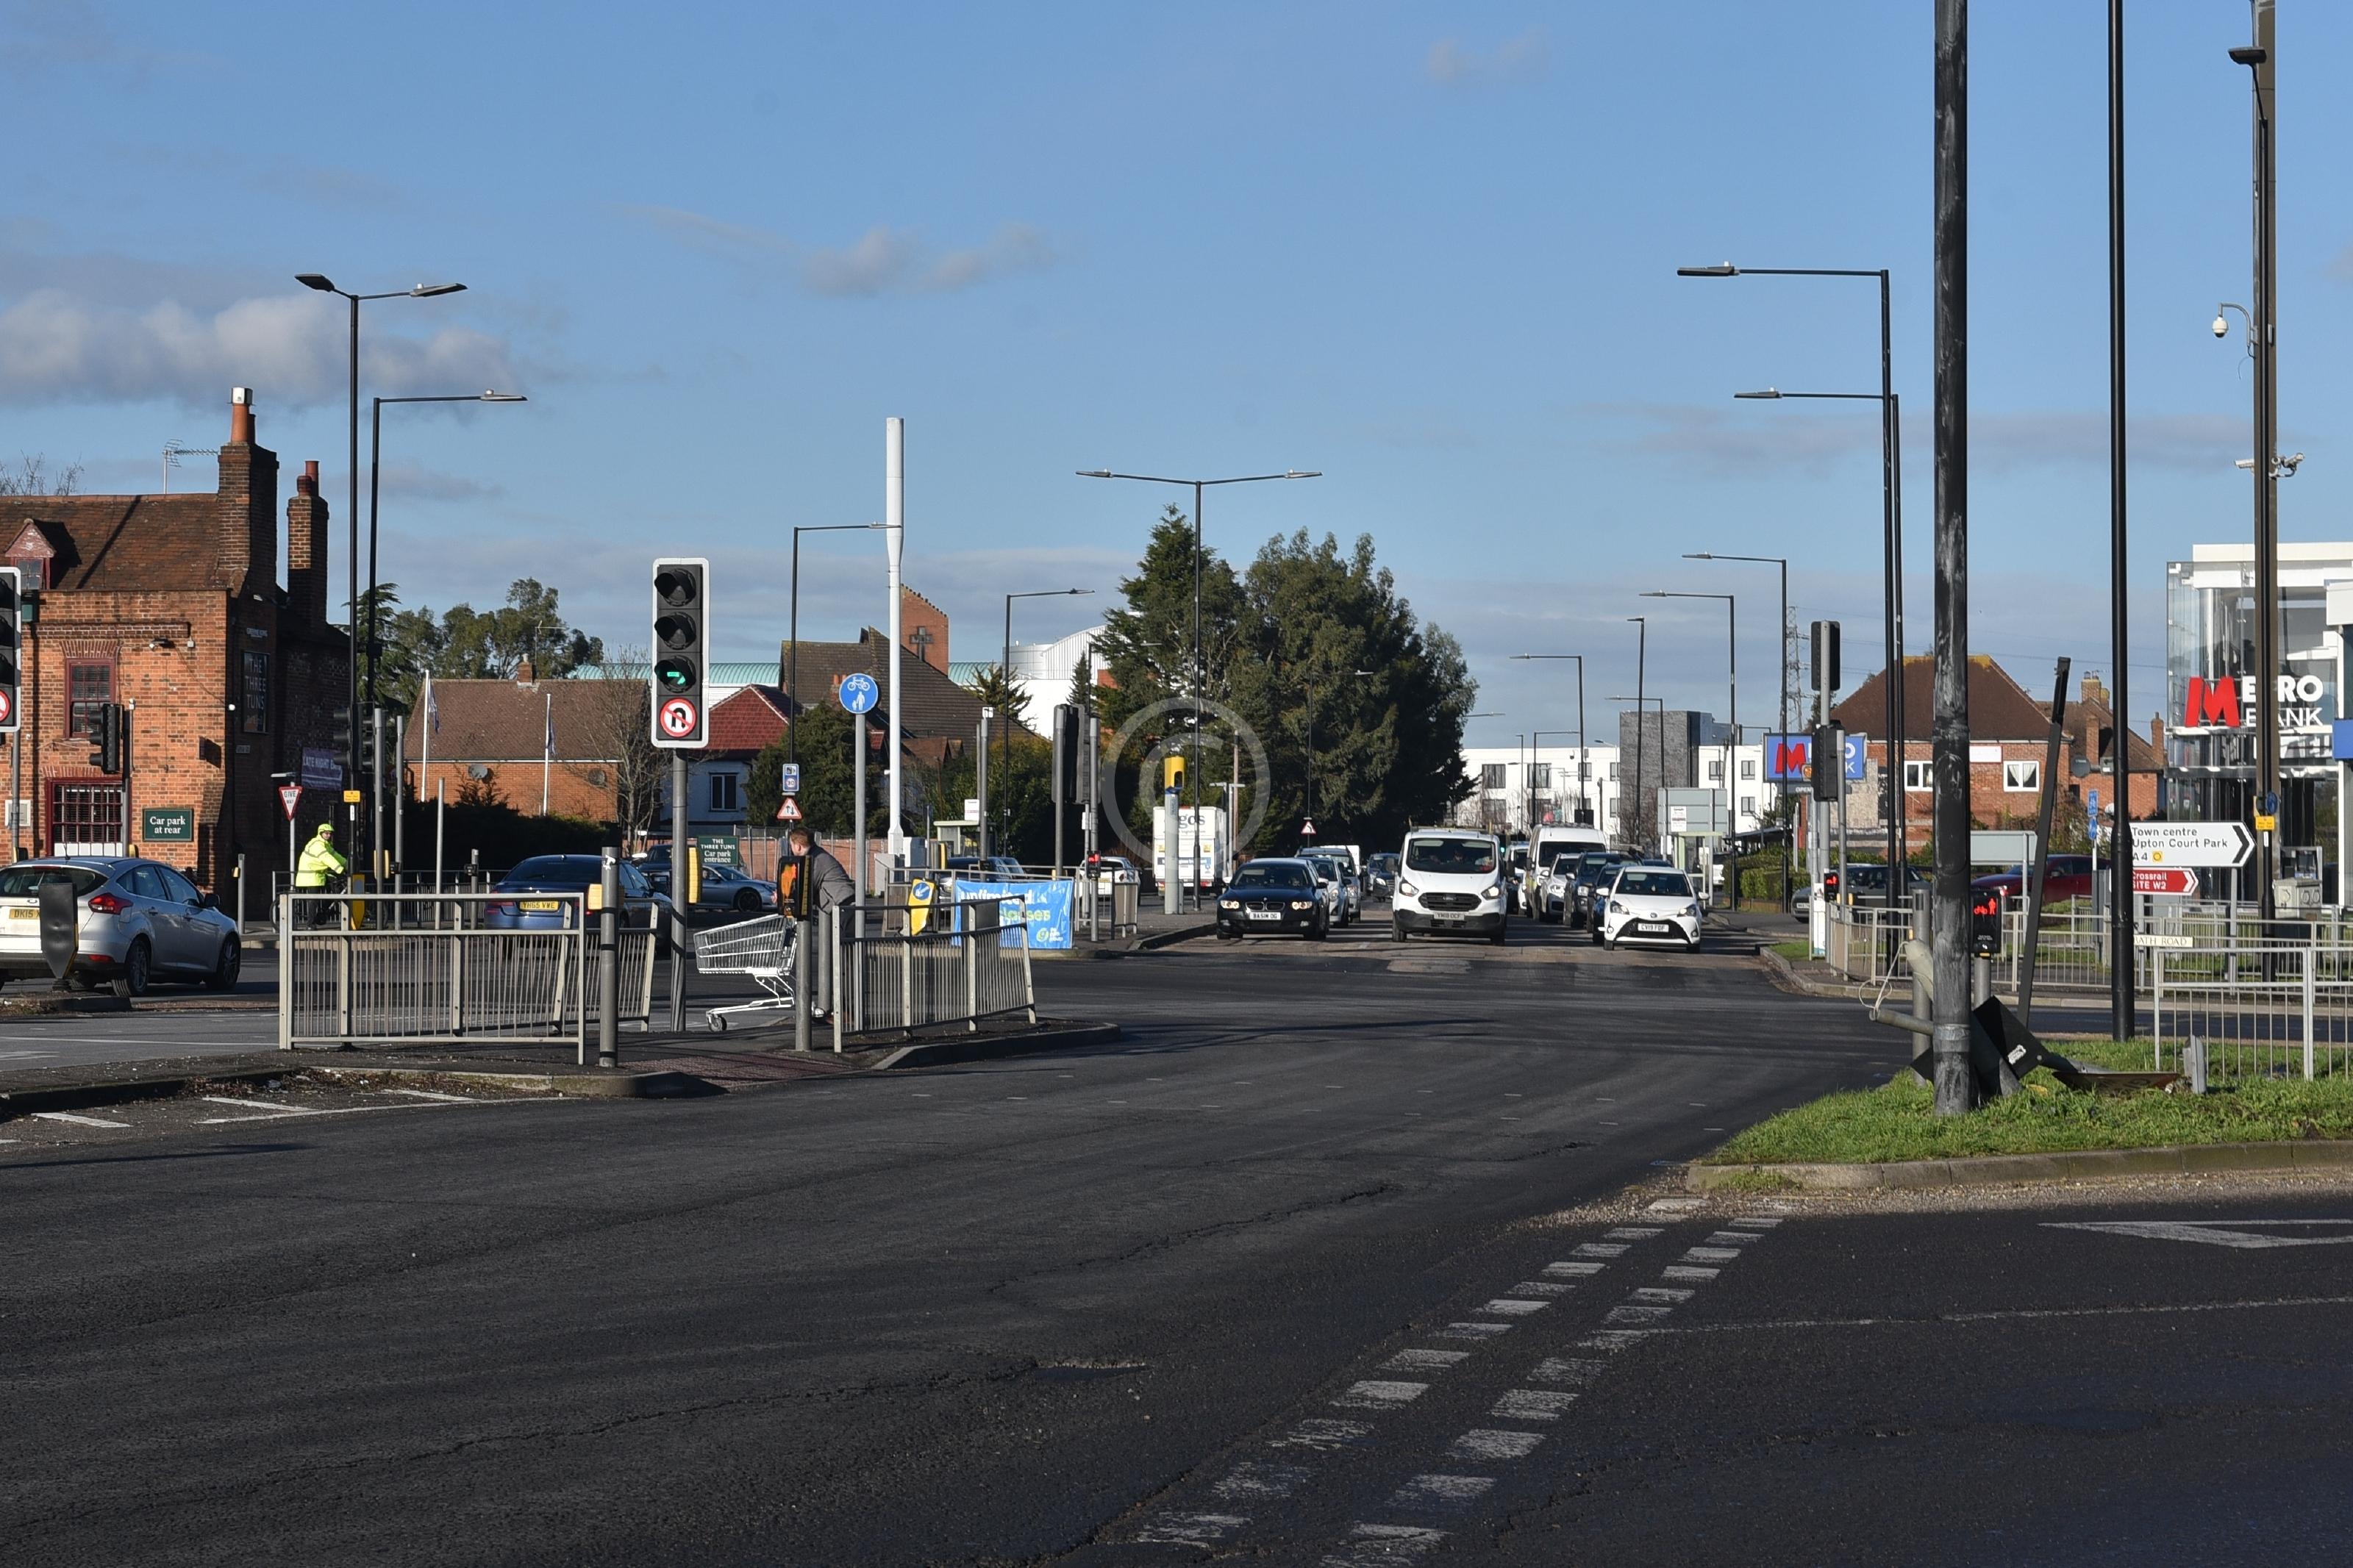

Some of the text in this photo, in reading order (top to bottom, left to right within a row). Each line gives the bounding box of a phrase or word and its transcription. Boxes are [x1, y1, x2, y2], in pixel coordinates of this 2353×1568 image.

[249, 658, 262, 673] THE
[245, 676, 266, 692] THREE
[246, 694, 265, 709] TUNS
[2185, 675, 2324, 728] MERO
[2246, 707, 2324, 727] BNK
[283, 790, 296, 798] GIVE
[150, 815, 185, 826] Car park
[2132, 827, 2198, 837] Town centre
[2132, 838, 2229, 850] Upton Court Park
[717, 850, 731, 858] park
[2152, 881, 2167, 890] W2
[13, 908, 35, 918] DK15
[2161, 937, 2188, 947] ROAD
